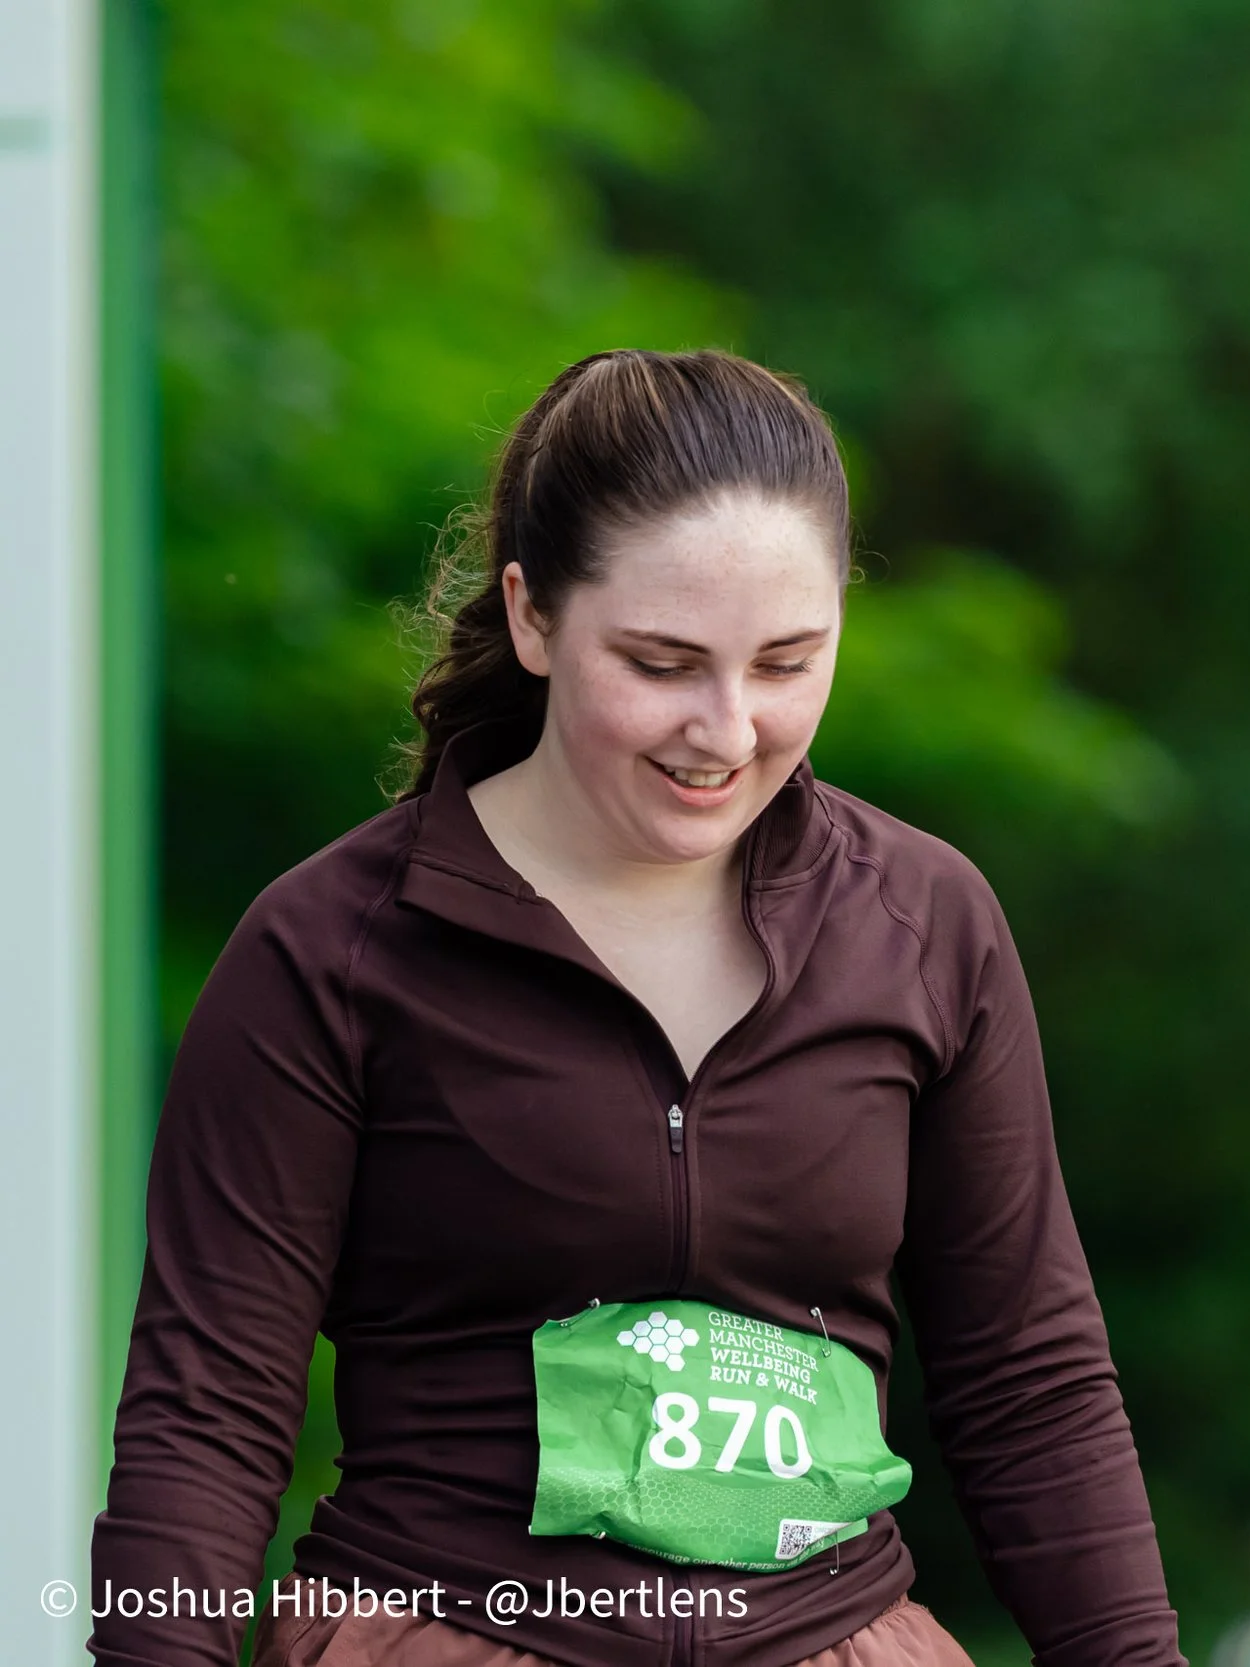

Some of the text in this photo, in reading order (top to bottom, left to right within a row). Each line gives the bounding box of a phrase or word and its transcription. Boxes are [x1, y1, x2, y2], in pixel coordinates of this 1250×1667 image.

[708, 1311, 784, 1341] GREATER
[709, 1328, 819, 1372] MANCHESTER
[710, 1347, 811, 1384] WELLBEING
[710, 1365, 818, 1405] RUN & WALK
[648, 1391, 813, 1480] 870
[718, 1557, 748, 1570] other
[747, 1562, 786, 1571] person
